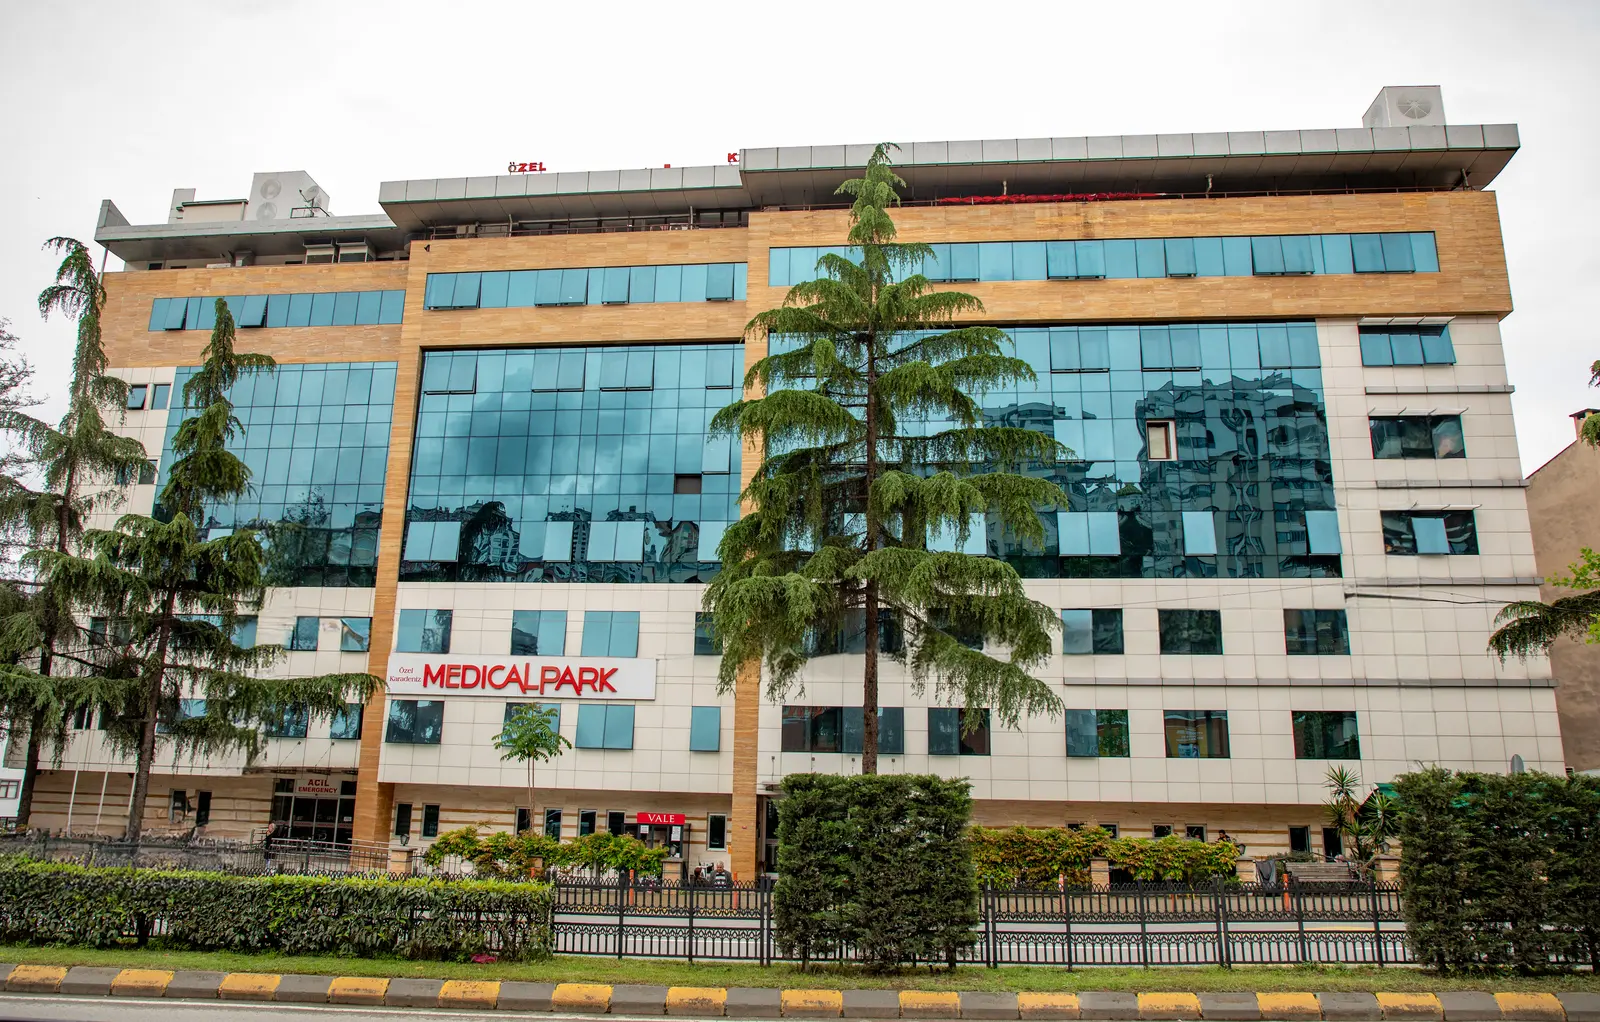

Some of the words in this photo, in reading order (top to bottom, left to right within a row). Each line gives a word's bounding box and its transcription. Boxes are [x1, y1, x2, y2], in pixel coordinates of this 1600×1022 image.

[508, 161, 546, 172] ÖZEL
[398, 666, 414, 674] Özel
[389, 675, 422, 683] Karadeniz
[647, 813, 676, 823] VALE
